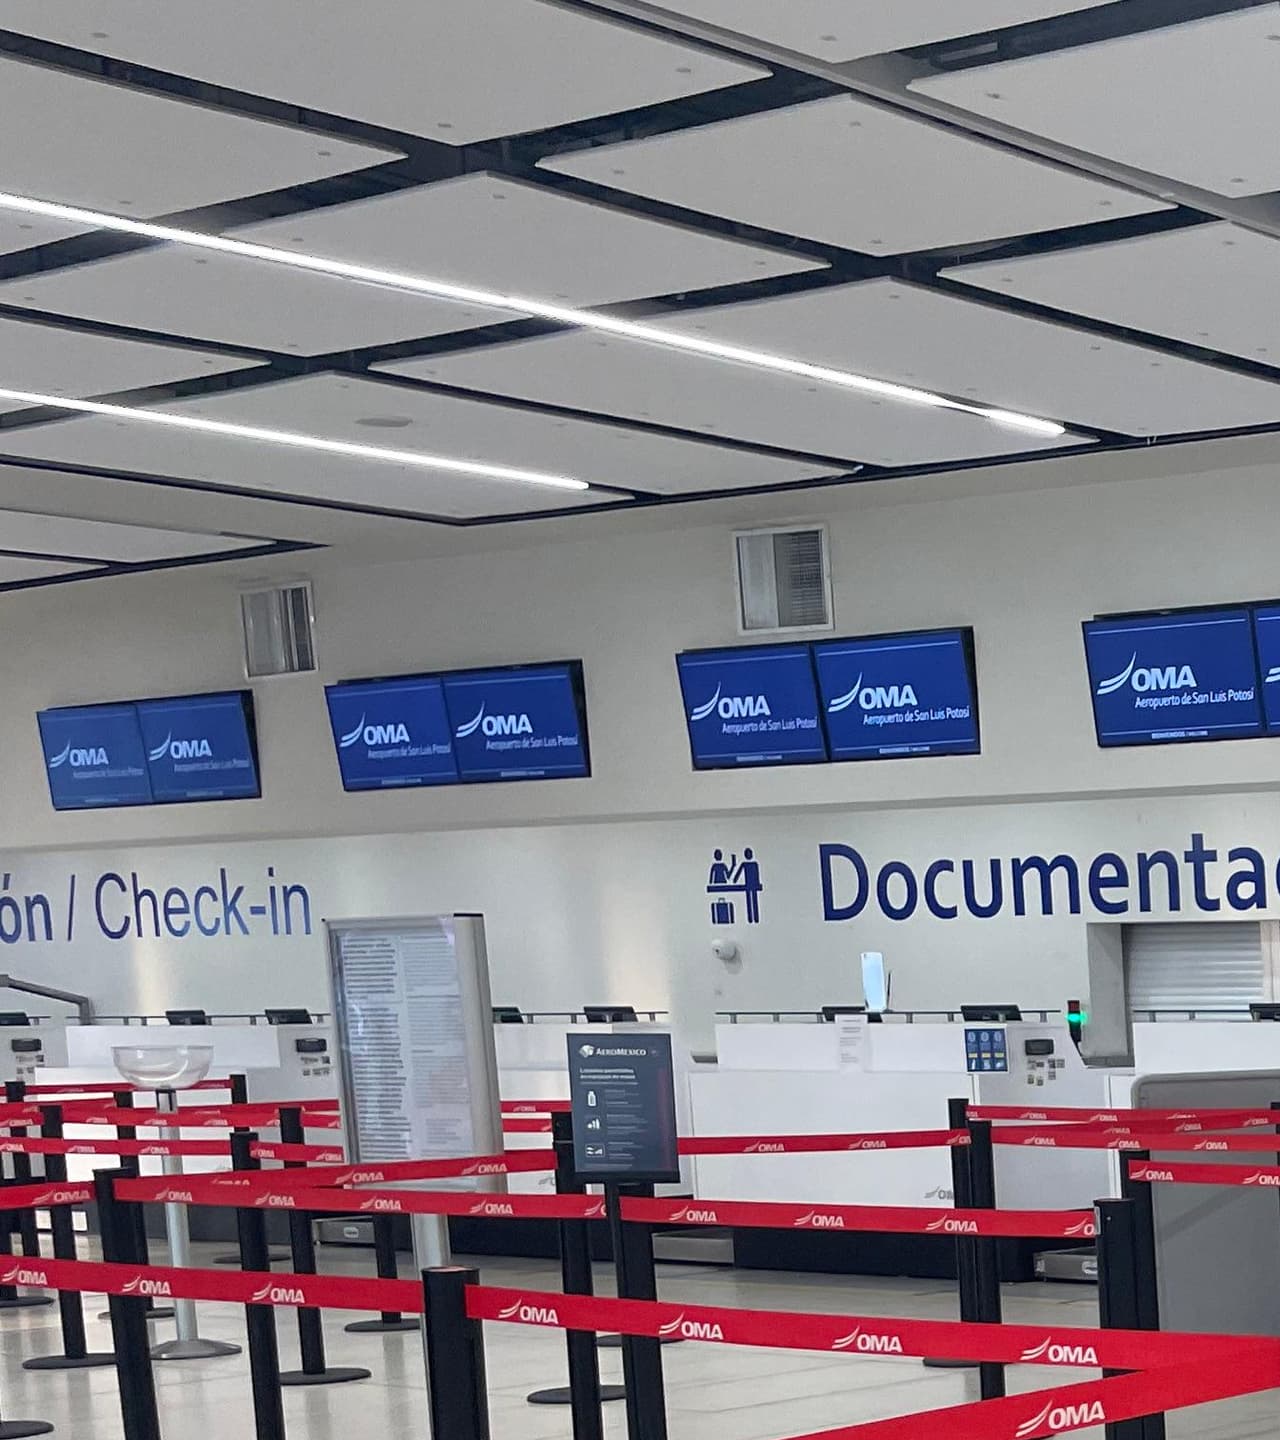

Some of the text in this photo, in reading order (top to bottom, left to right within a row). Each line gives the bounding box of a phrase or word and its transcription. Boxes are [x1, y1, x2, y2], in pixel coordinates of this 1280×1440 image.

[1131, 665, 1196, 692] OMA
[859, 685, 917, 709] OMA
[1135, 688, 1254, 710] Aeropuerto de San Luis Potosí
[718, 696, 770, 718] OMA
[364, 724, 410, 745] OMA
[482, 715, 532, 735] OMA
[69, 748, 108, 766] OMA
[171, 740, 212, 758] OMA
[95, 867, 311, 939] Check-in
[1146, 1170, 1174, 1181] OMA
[485, 1203, 513, 1216] OMA
[686, 1209, 718, 1223] OMA
[812, 1215, 844, 1228] OMA
[944, 1220, 978, 1233] OMA
[18, 1268, 48, 1285] OMA
[140, 1279, 172, 1296] OMA
[271, 1288, 305, 1305] OMA
[519, 1306, 558, 1325] OMA
[681, 1319, 724, 1341] OMA
[856, 1333, 903, 1353] OMA
[1048, 1344, 1098, 1364] OMA
[1047, 1400, 1106, 1429] OMA
